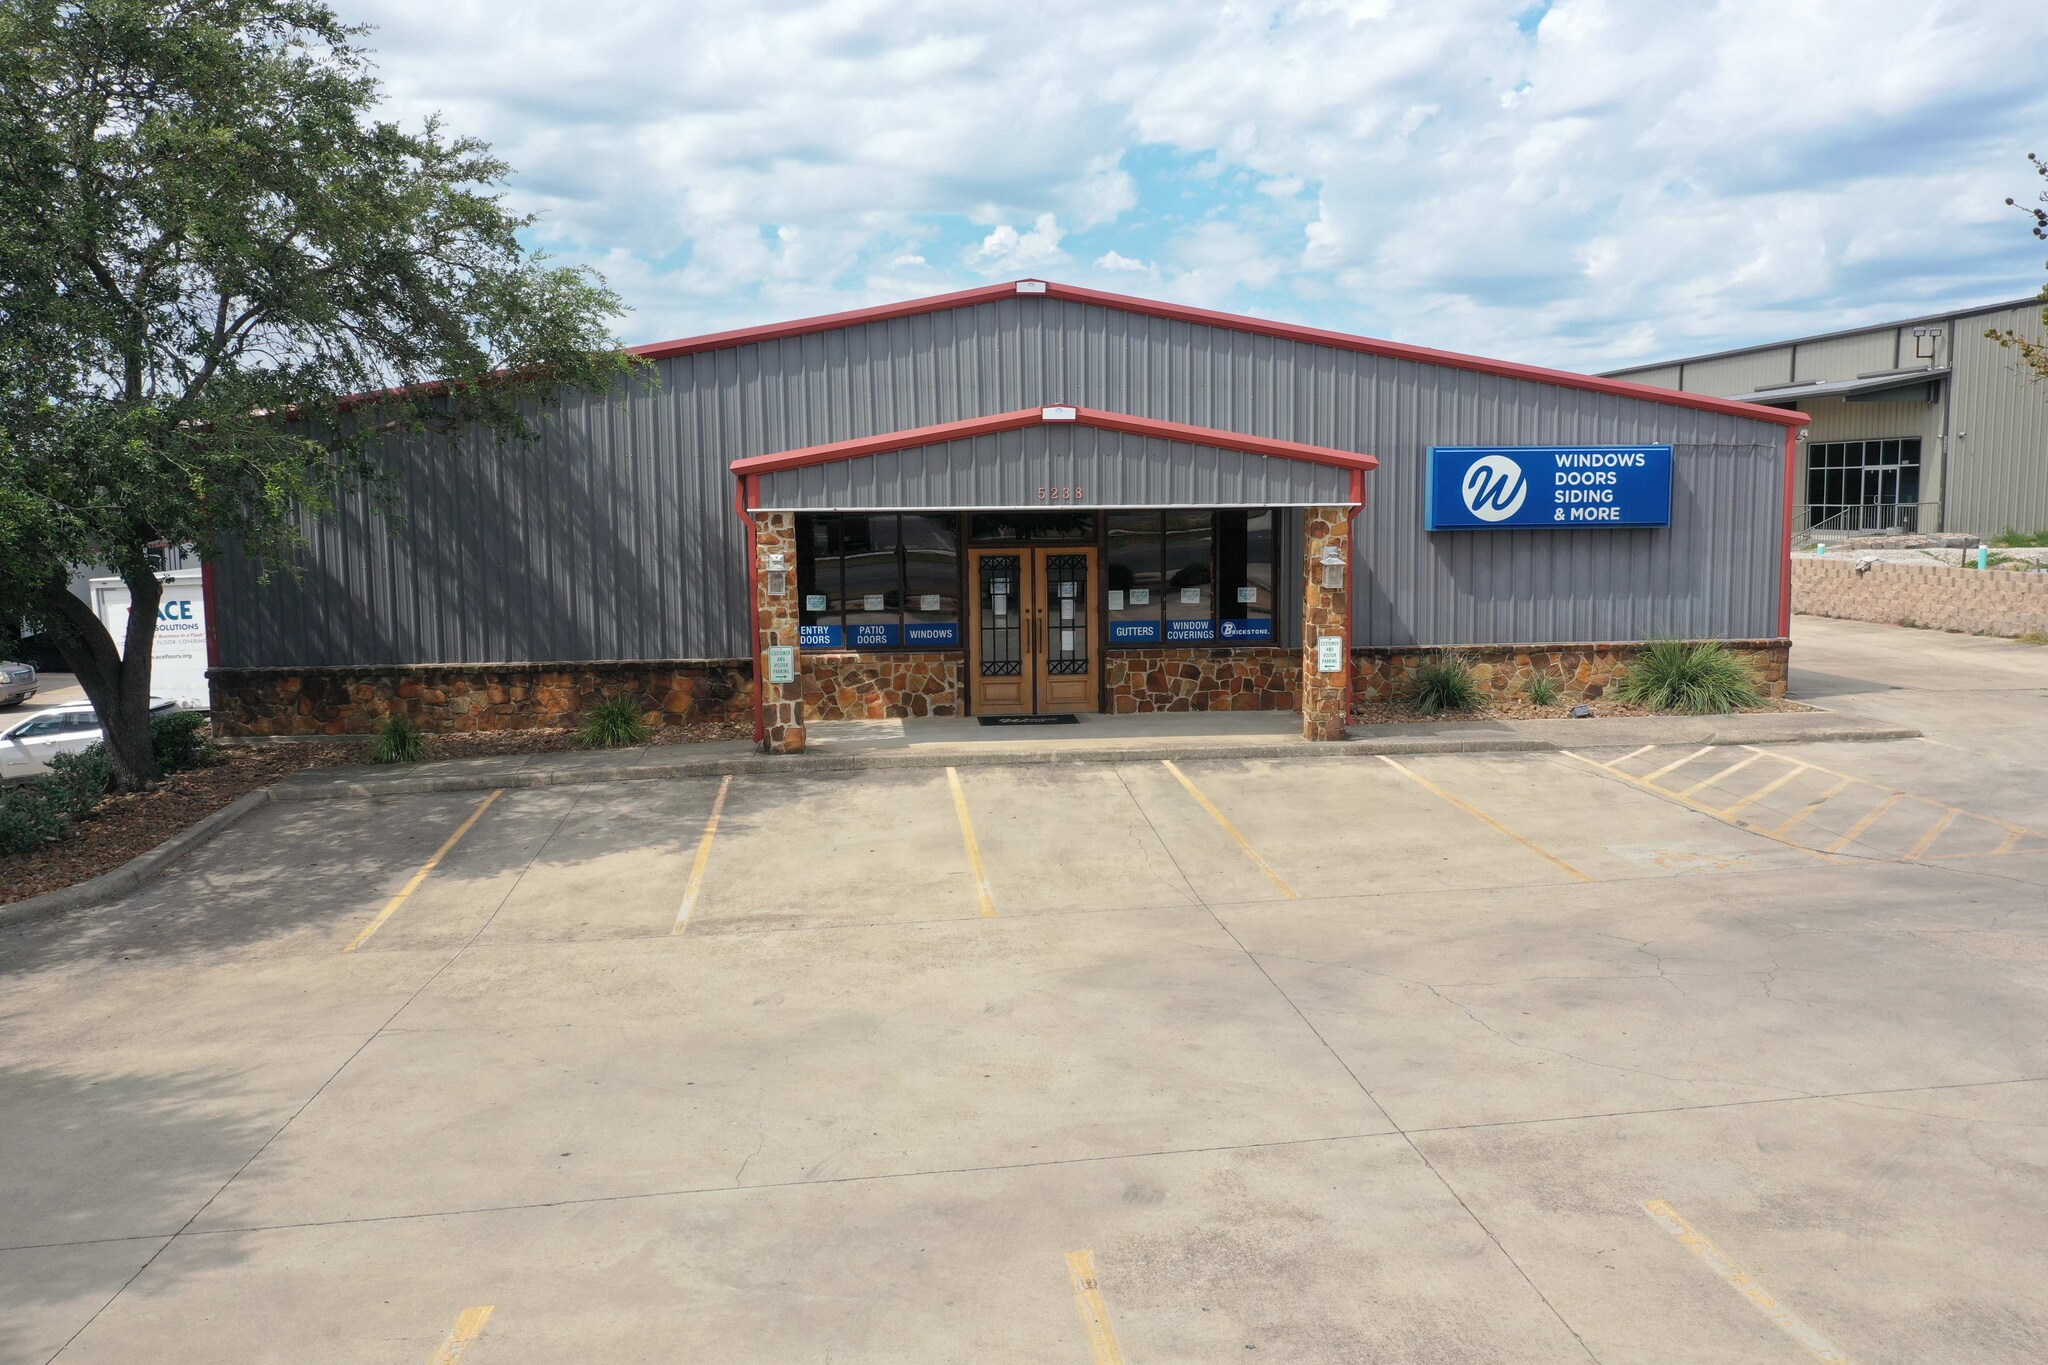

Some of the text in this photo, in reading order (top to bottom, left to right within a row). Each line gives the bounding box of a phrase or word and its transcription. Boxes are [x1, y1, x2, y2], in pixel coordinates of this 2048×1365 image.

[1555, 453, 1645, 467] WINDOWS
[1555, 471, 1617, 486] DOORS
[1038, 486, 1082, 500] 5238
[1554, 489, 1613, 503] SIDING
[1554, 507, 1620, 521] & MORE
[155, 623, 199, 631] SOLUTIONS
[800, 626, 829, 635] ENTRY
[859, 625, 885, 634] PATIO
[1172, 621, 1209, 630] WINDOW
[909, 629, 953, 639] WINDOWS
[1116, 626, 1154, 637] GUTTERS
[1167, 630, 1215, 640] COVERINGS
[800, 635, 830, 645] DOORS
[857, 635, 887, 644] DOORS
